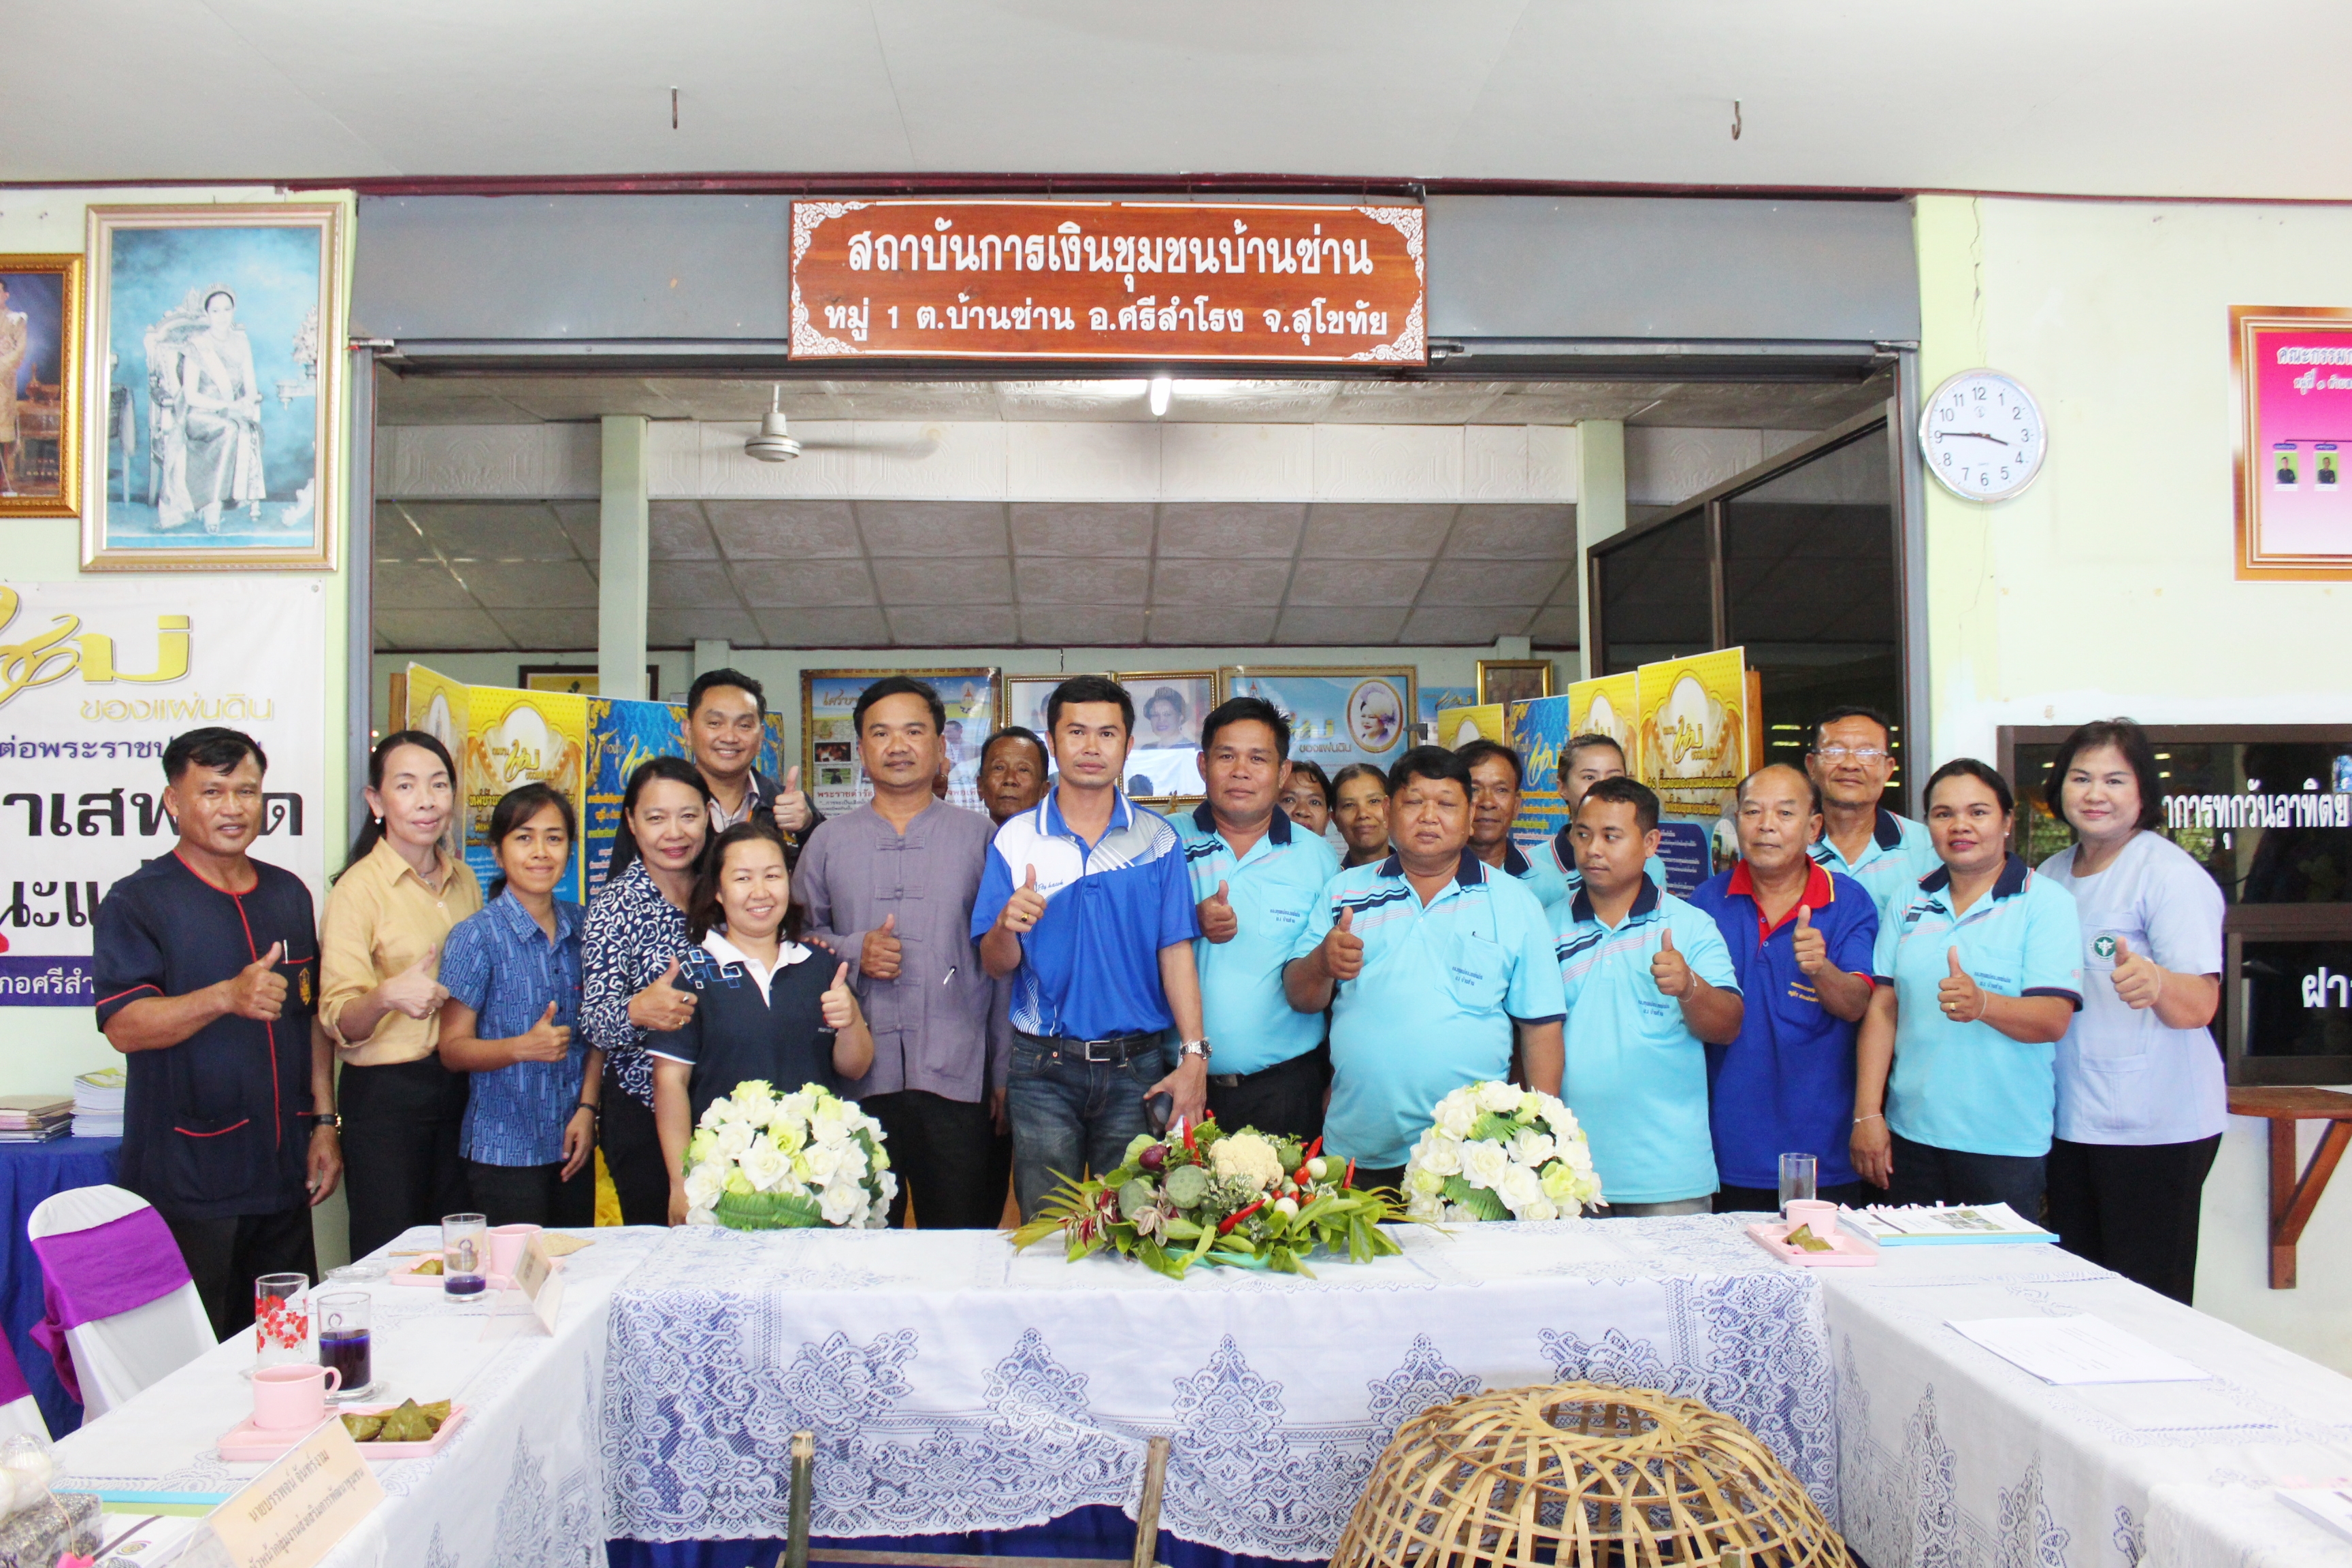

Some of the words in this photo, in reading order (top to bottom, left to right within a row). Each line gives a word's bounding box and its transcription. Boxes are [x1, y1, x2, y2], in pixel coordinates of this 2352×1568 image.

[848, 217, 1373, 293] สถาบันการเงินชุมชนบ้านซ่าน
[824, 300, 869, 342] หมู่
[887, 306, 898, 329] 1
[917, 292, 1075, 331] ต.บ้านซ่าน
[1090, 295, 1244, 333] อ.ศรีสำโรง
[1262, 297, 1388, 345] จ.สุโขทัย
[1953, 393, 1964, 407] 11
[1972, 387, 1987, 400] 12
[1999, 393, 2004, 406] 1
[1940, 408, 1954, 422] 10
[2012, 406, 2021, 420] 2
[1934, 430, 1942, 444] 9
[2021, 429, 2029, 442] 3
[1943, 453, 1952, 466] 8
[2015, 451, 2023, 464] 4
[1961, 467, 1970, 480] 7
[1980, 472, 1989, 486] 6
[2000, 466, 2008, 480] 5
[2302, 966, 2352, 1008] ฝา
